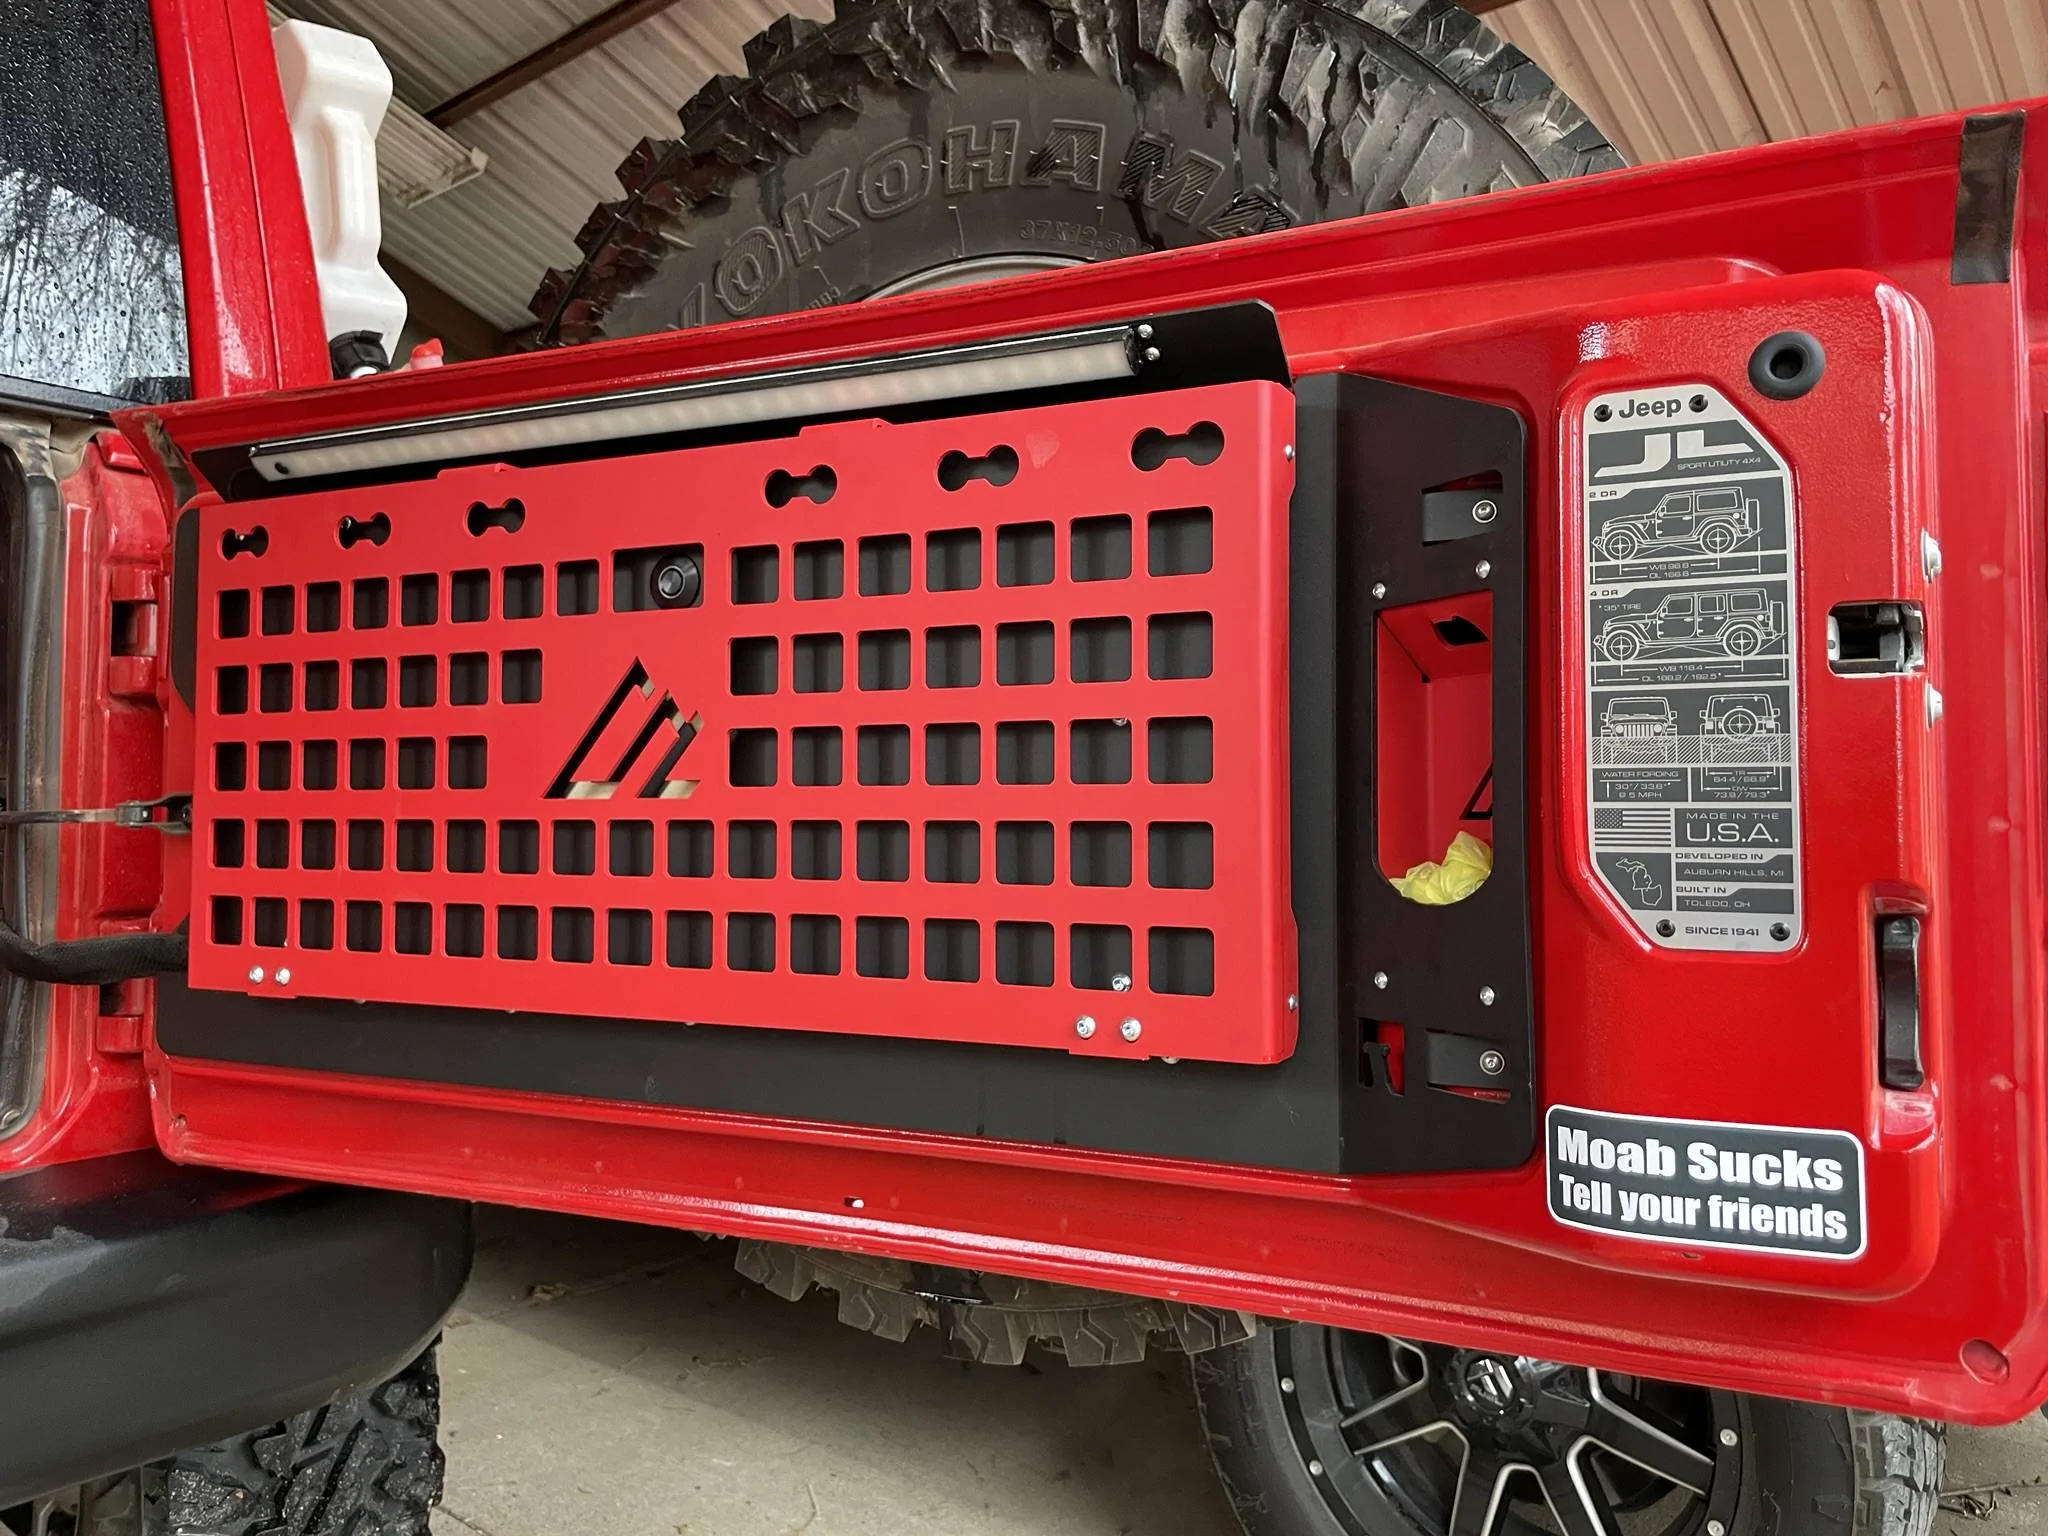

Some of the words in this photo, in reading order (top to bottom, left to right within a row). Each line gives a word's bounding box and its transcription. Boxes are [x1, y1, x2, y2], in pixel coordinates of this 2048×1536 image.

[1618, 398, 1682, 418] Jeep
[1594, 429, 1754, 478] JL
[1677, 461, 1707, 471] SPORT
[1708, 459, 1740, 468] UTILITY
[1600, 490, 1617, 498] DR
[1622, 602, 1641, 610] TIRE
[1686, 812, 1728, 820] MADE
[1732, 812, 1747, 820] IN
[1752, 812, 1780, 820] THE
[1686, 822, 1779, 842] U.S.A.
[1676, 852, 1748, 860] DEVELOPED
[1683, 868, 1731, 876] AUBURN
[1733, 869, 1768, 877] HILLS,
[1770, 869, 1784, 877] MI
[1683, 899, 1732, 908] TOLEDO,
[1734, 900, 1751, 908] OH
[1685, 926, 1729, 935] SINCE
[1731, 927, 1759, 936] 1941
[1557, 1125, 1676, 1178] Moab
[1687, 1141, 1844, 1192] Sucks
[1558, 1173, 1612, 1216] Tell
[1619, 1189, 1701, 1227] your
[1707, 1194, 1848, 1241] friends
